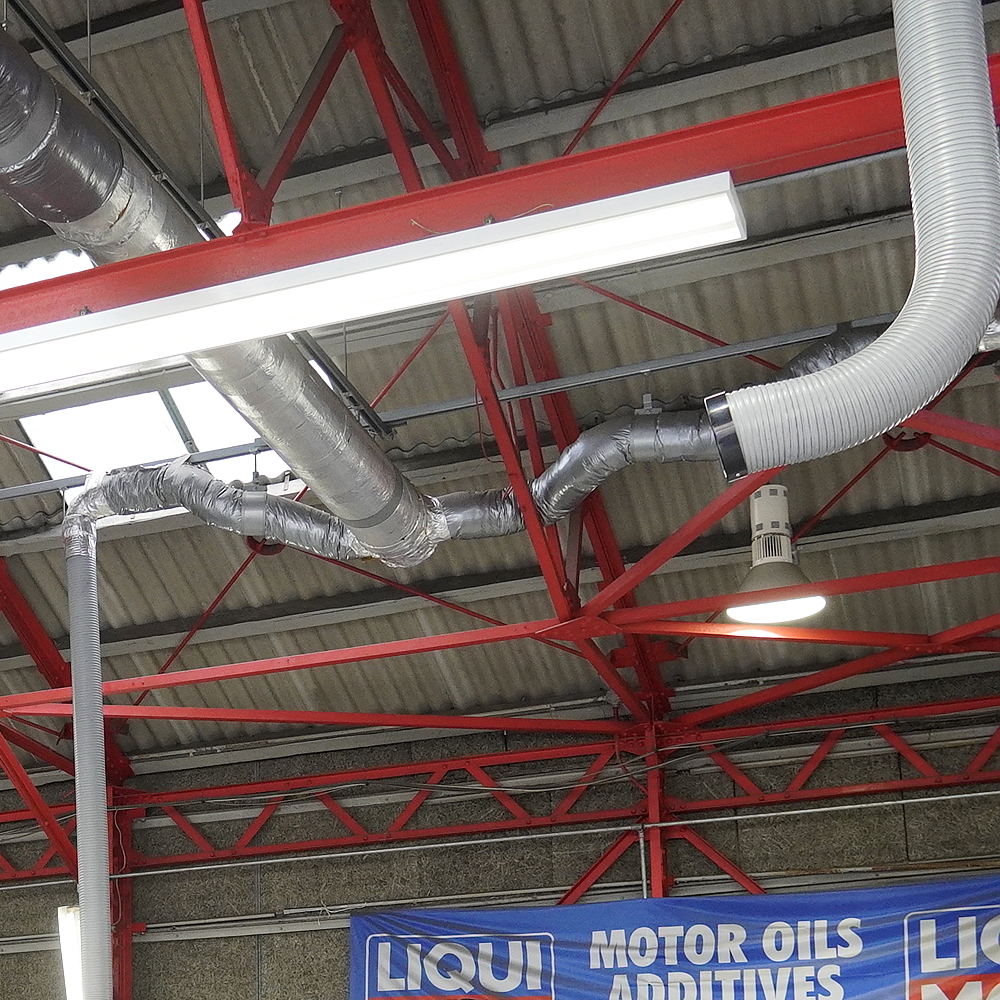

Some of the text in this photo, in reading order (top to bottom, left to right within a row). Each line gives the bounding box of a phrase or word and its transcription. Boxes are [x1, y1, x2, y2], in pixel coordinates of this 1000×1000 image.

[377, 940, 543, 993] LIQUI
[589, 917, 863, 969] MOTOR OILS
